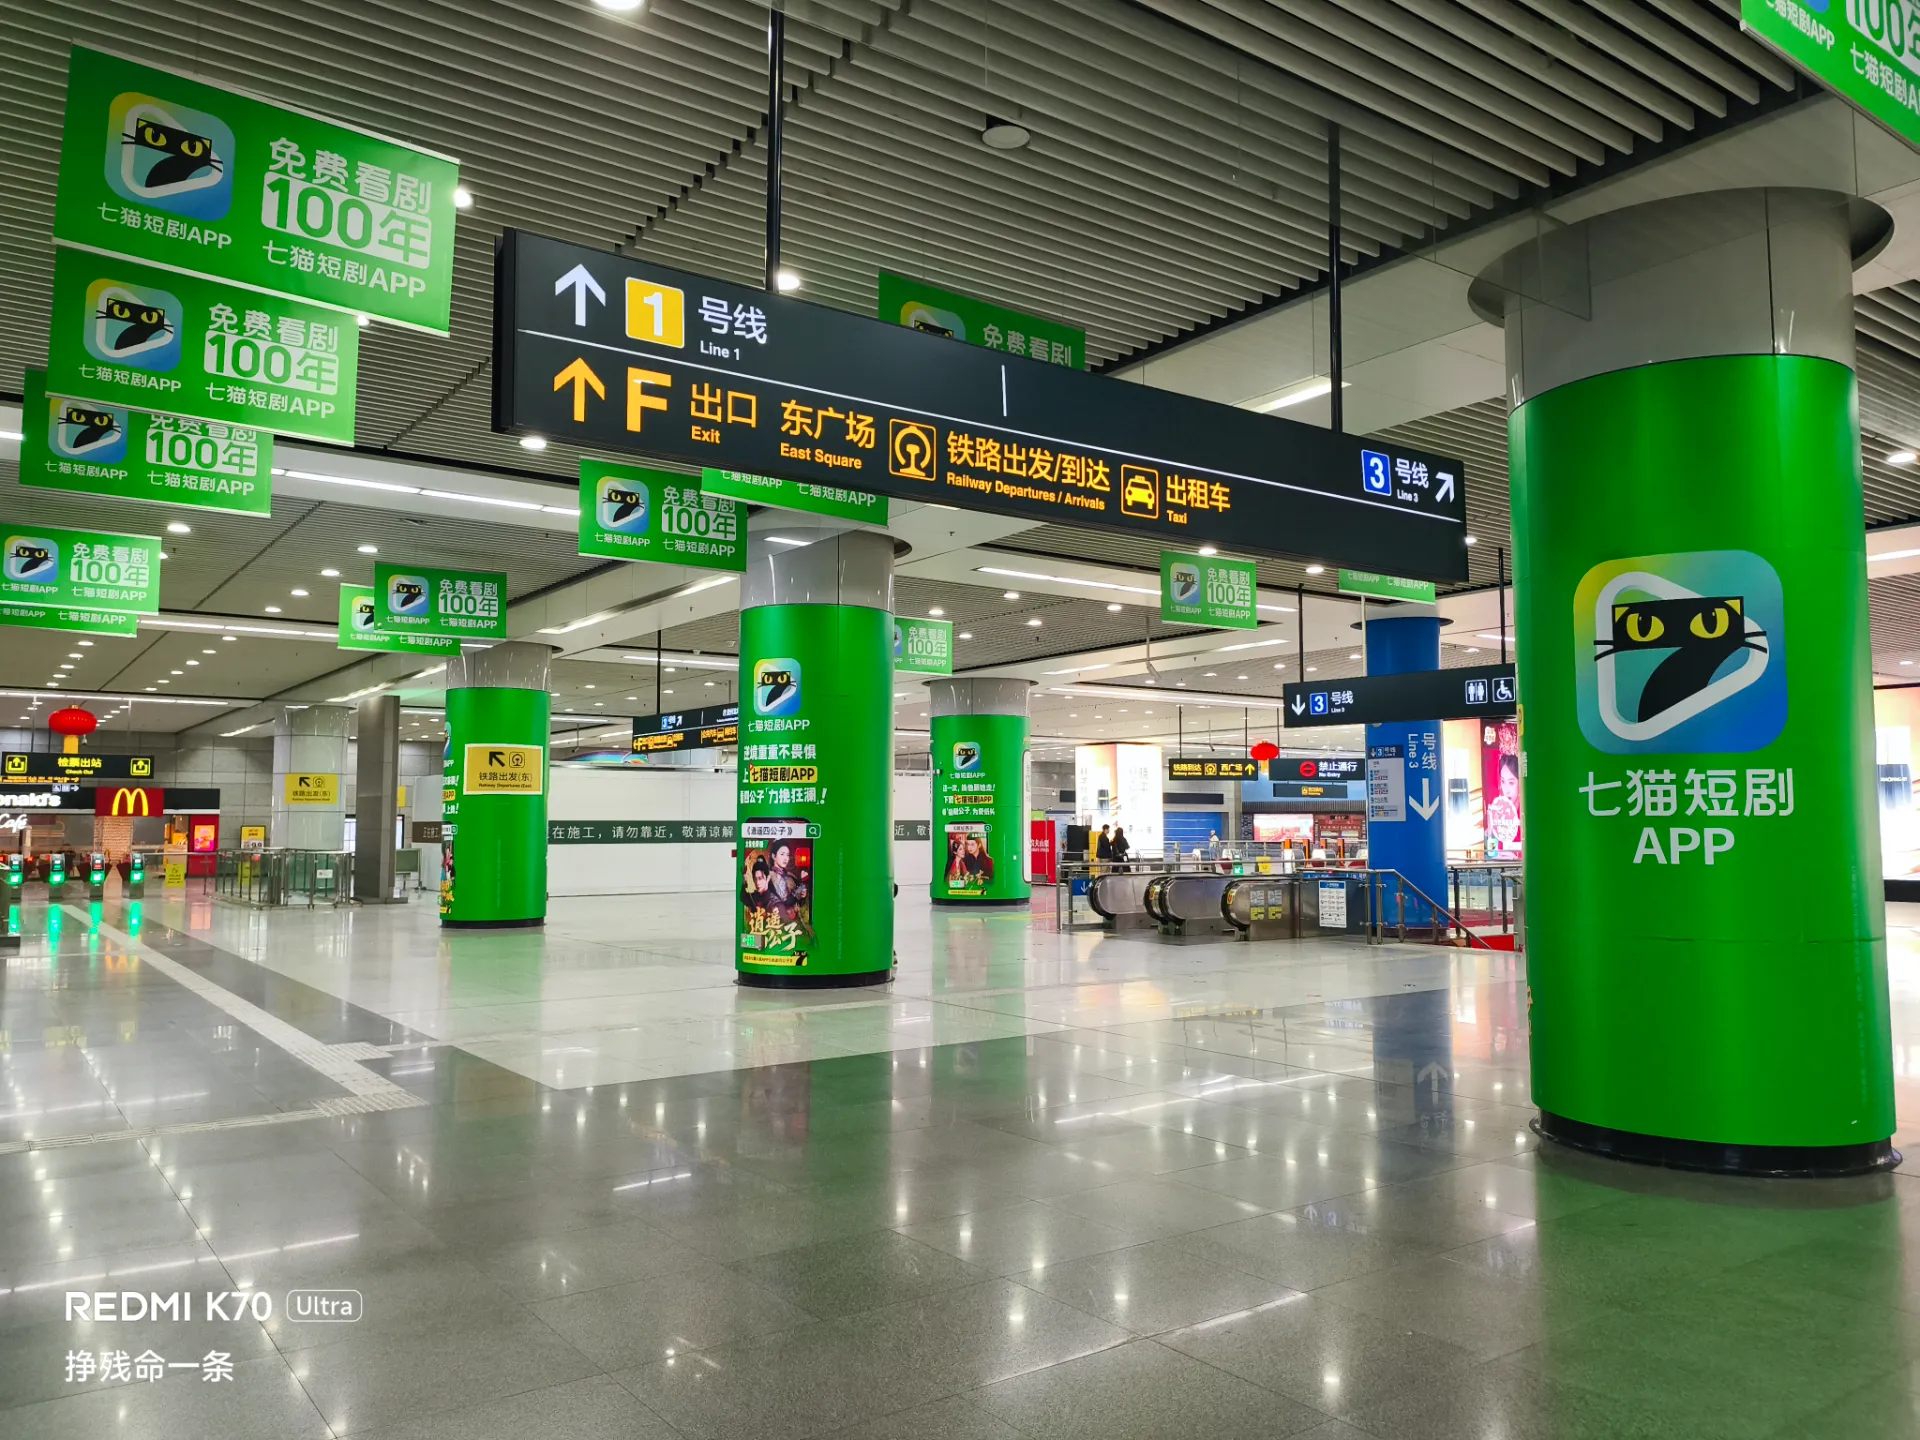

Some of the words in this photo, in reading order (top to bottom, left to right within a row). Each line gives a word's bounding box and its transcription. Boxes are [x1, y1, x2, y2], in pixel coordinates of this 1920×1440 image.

[268, 136, 431, 214] 免费看剧
[97, 202, 232, 249] 七猫短剧APP
[264, 174, 430, 268] 100年
[262, 240, 426, 298] 七猫短剧APP
[208, 303, 339, 351] 免费看剧
[643, 292, 663, 337] 1
[698, 295, 767, 345] 号线
[700, 340, 730, 358] Line
[733, 347, 740, 361] 1
[206, 334, 337, 394] 100年
[78, 364, 182, 392] 七猫短剧APP
[204, 382, 335, 419] 七猫短剧APP
[626, 366, 671, 433] F
[690, 382, 757, 428] 出口
[780, 399, 876, 449] 东广场
[947, 430, 1111, 493] 铁路出发/到达
[1166, 475, 1231, 513] 出租车
[148, 431, 257, 476] 100年
[44, 461, 128, 480] 七猫短剧APP
[691, 425, 721, 444] Exit
[780, 442, 810, 461] East
[815, 448, 863, 470] Square
[946, 472, 992, 494] Railway
[995, 479, 1056, 503] Departures
[1064, 492, 1106, 511] Arrivals
[1167, 509, 1188, 525] Taxi
[720, 469, 783, 489] 七猫短剧APP
[1370, 456, 1385, 490] 3
[1395, 458, 1430, 489] 号线
[147, 471, 255, 496] 七猫短剧APP
[796, 482, 877, 507] 七猫短剧APP
[1397, 488, 1412, 502] Line
[1413, 492, 1419, 503] 3
[663, 508, 735, 540] 100年
[594, 532, 650, 549] 七猫短剧APP
[662, 538, 735, 558] 七猫短剧APP
[73, 542, 149, 563] 免费看剧
[72, 561, 148, 586] 100年
[1, 582, 58, 595] 七猫短剧APP
[71, 586, 147, 601] 七猫短剧APP
[439, 578, 498, 597] 免费看剧
[1208, 582, 1250, 606] 100年
[441, 594, 497, 616] 100年
[58, 610, 127, 625] 七猫短剧APP
[387, 615, 430, 625] 七猫短剧APP
[440, 616, 497, 630] 七猫短剧APP
[398, 635, 453, 648] 七猫短剧APP
[909, 639, 946, 656] 100年
[1314, 695, 1324, 713] 3
[1330, 690, 1354, 705] 号线
[748, 719, 811, 732] 七猫短剧APP
[743, 743, 817, 761] 逆境重重不畏惧
[1408, 733, 1419, 758] Line
[1421, 732, 1438, 771] 号线
[57, 757, 102, 768] 检票出站
[1221, 763, 1243, 772] 西广场
[1319, 761, 1358, 772] 禁止通行
[1409, 761, 1419, 769] 3
[478, 772, 533, 782] 铁路出发(东)
[751, 767, 816, 782] 七猫短剧APP
[1578, 767, 1795, 817] 七猫短剧
[547, 825, 735, 839] 在施工，请勿靠近，敬请谅解
[746, 827, 793, 836] 《逍遥四公子》
[1632, 826, 1736, 866] APP
